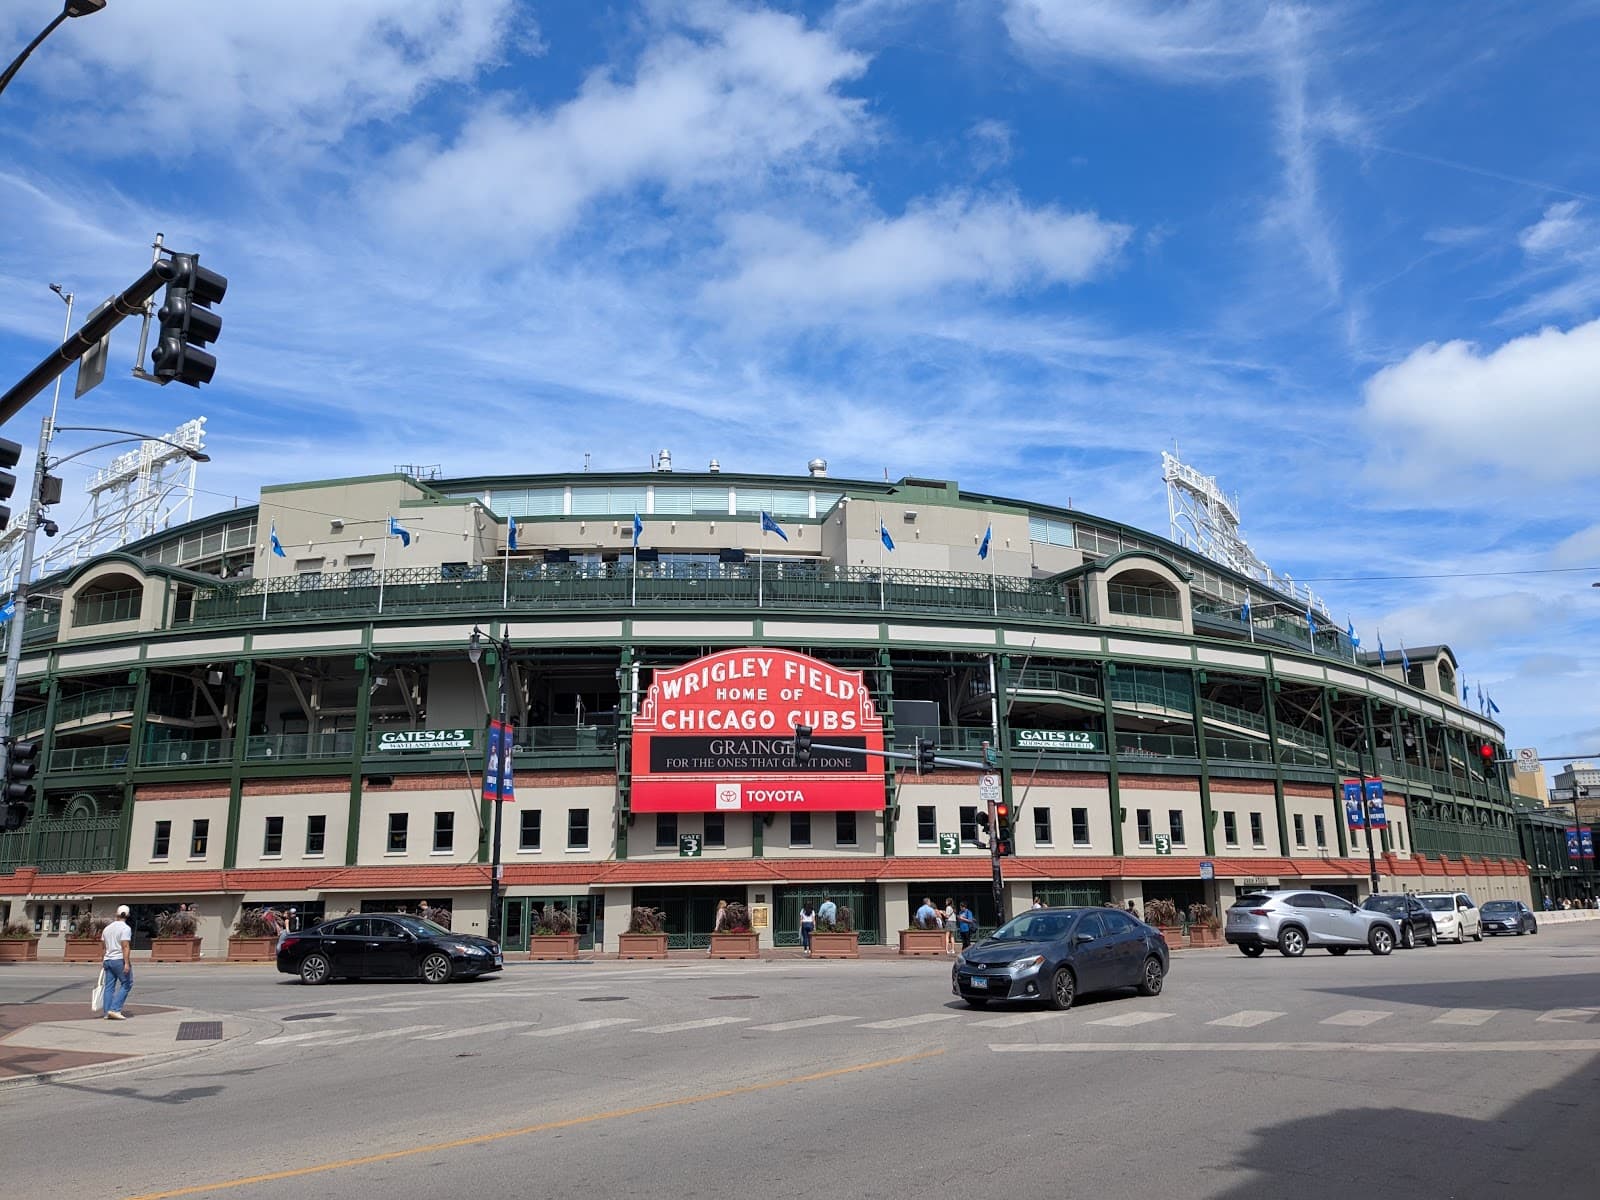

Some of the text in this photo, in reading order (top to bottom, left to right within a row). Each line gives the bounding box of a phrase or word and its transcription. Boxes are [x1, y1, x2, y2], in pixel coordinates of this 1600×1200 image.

[661, 658, 855, 700] WRIGLEY FIELD
[716, 688, 803, 700] HOME OF
[661, 710, 856, 730] CHICAGO CUBS
[381, 732, 435, 742] GATES
[1020, 730, 1066, 741] GATES
[710, 740, 797, 755] GRAINGE
[666, 758, 689, 768] FOR
[692, 758, 715, 768] THE
[717, 758, 748, 768] ONES
[752, 758, 780, 768] THAT
[820, 758, 852, 768] DONE
[746, 790, 805, 802] TOYOTA
[683, 839, 698, 852] 3
[943, 838, 957, 850] 3
[1158, 839, 1169, 851] 3
